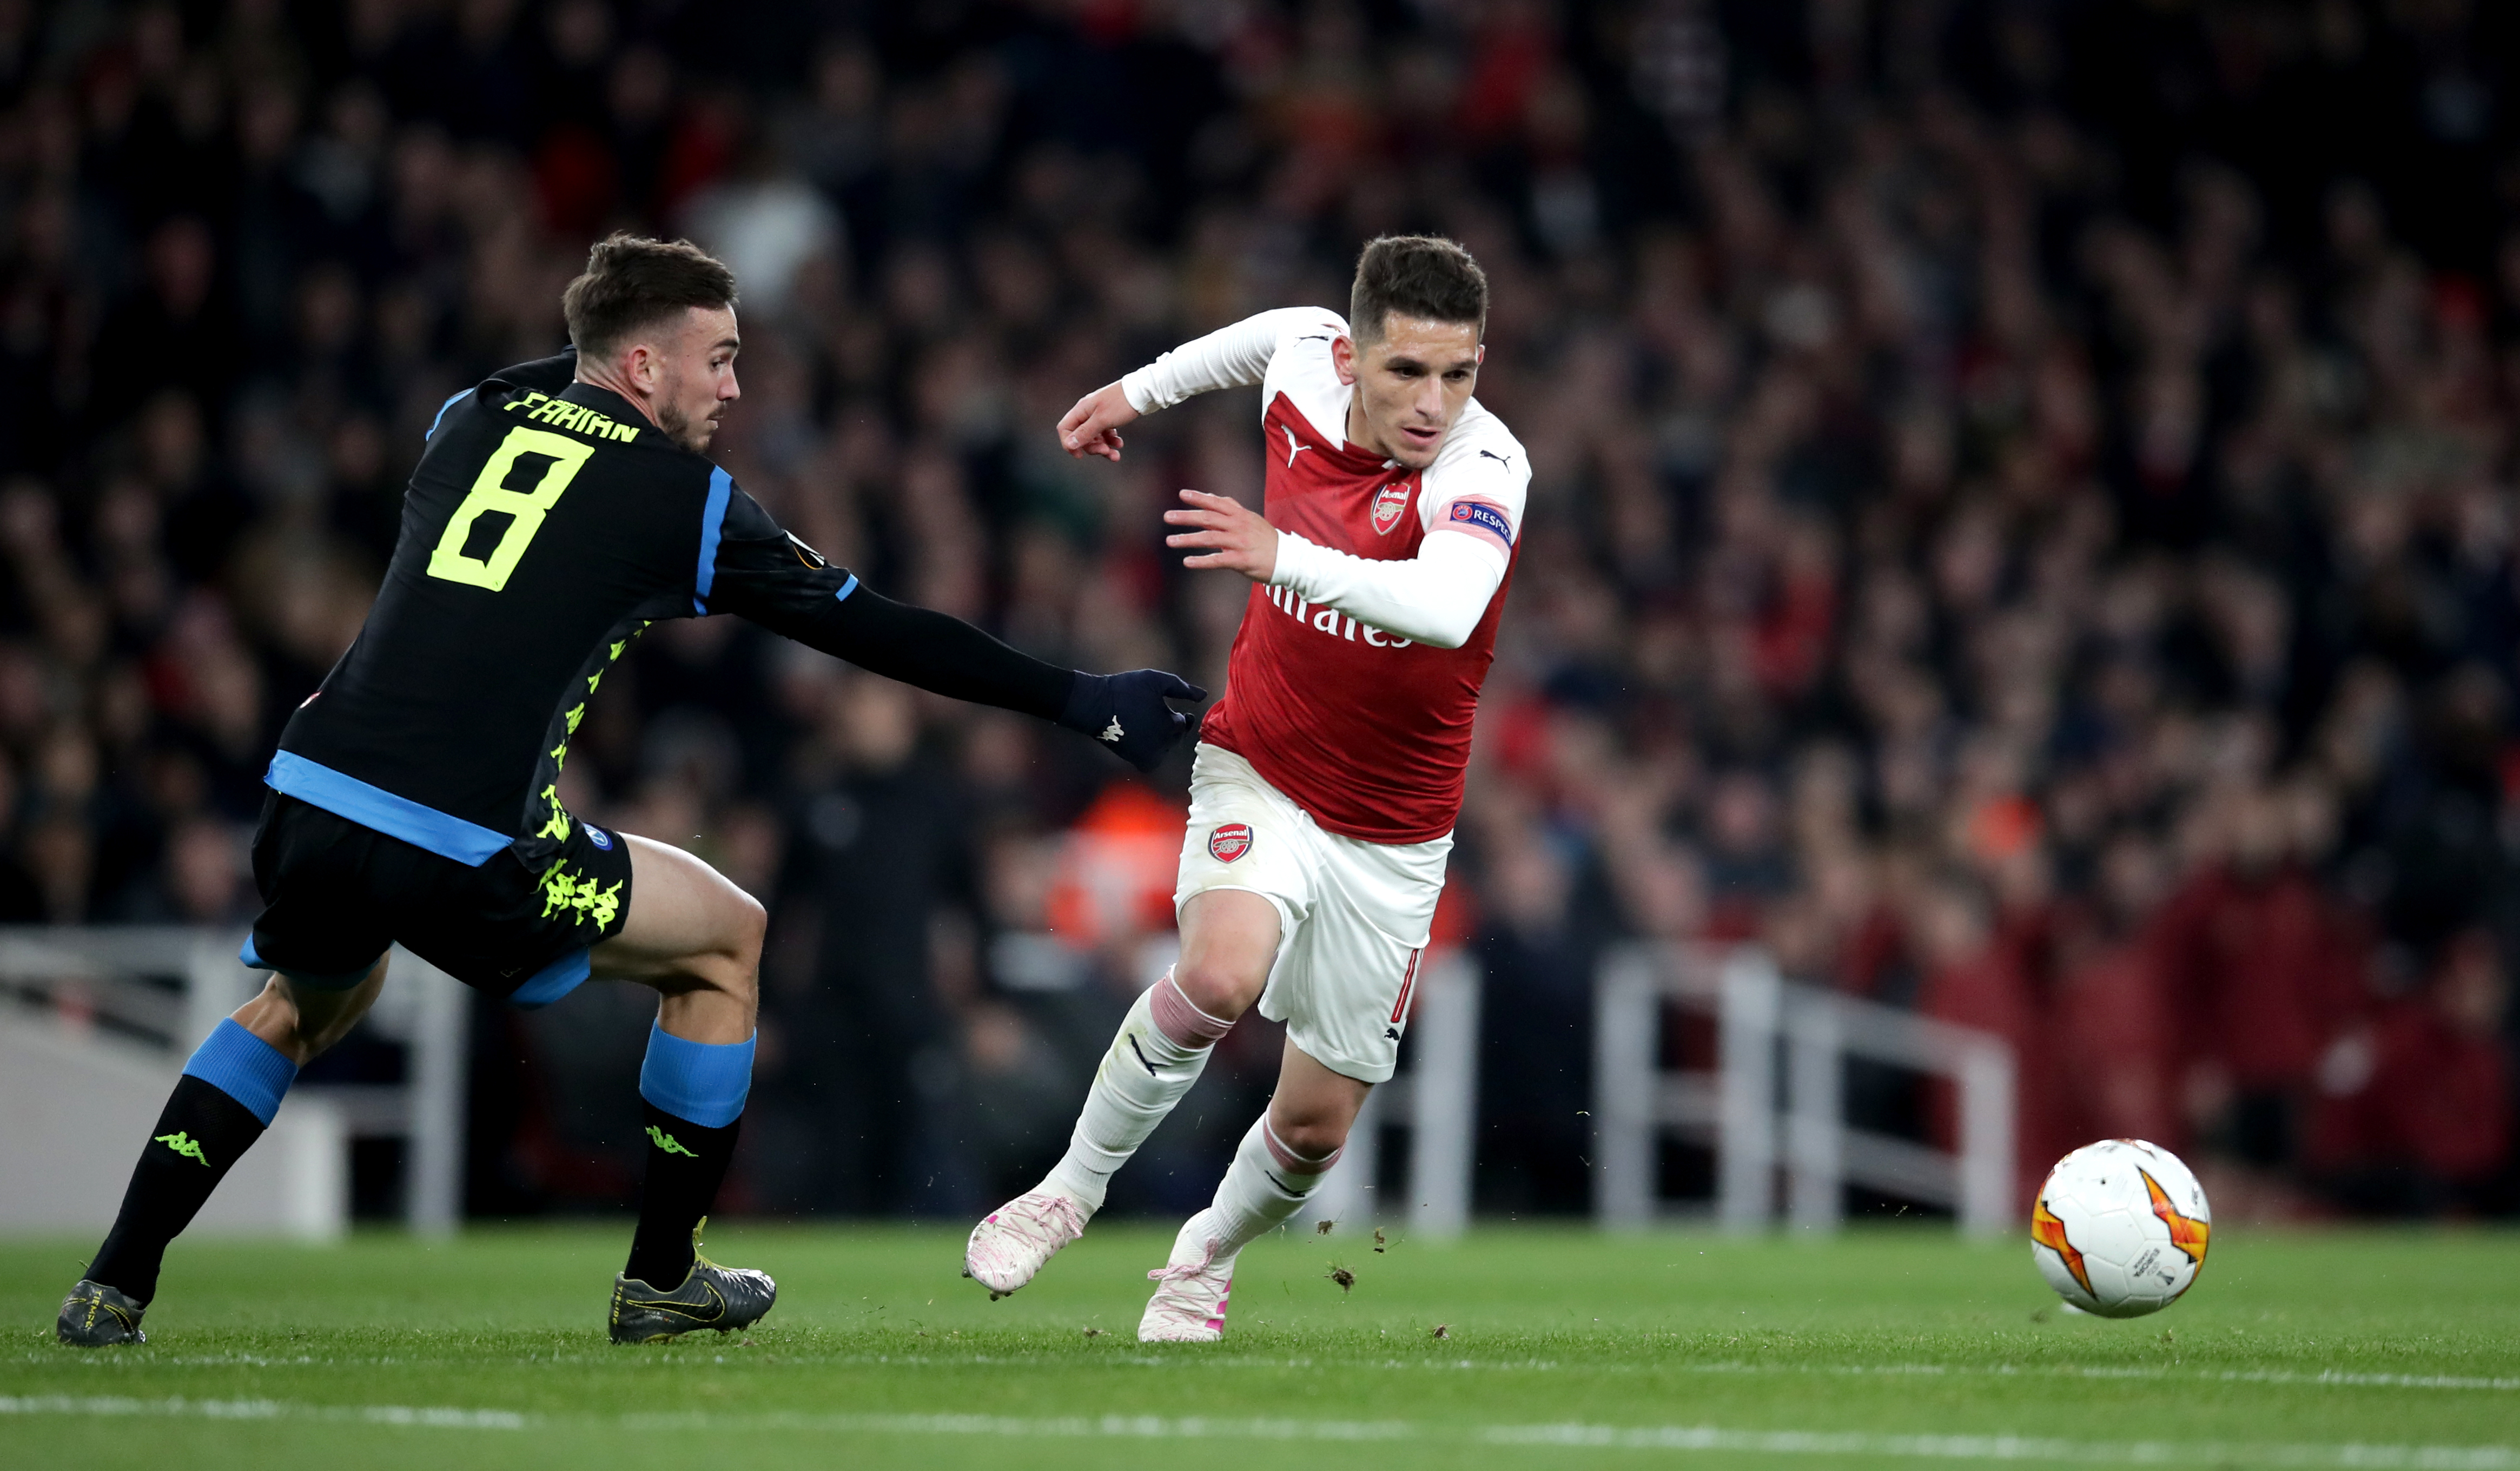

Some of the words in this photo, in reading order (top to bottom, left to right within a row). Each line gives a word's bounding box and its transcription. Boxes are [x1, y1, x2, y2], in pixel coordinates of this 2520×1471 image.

[426, 426, 595, 592] 8
[1474, 509, 1511, 544] RESPEC
[1214, 829, 1247, 840] Arsenal
